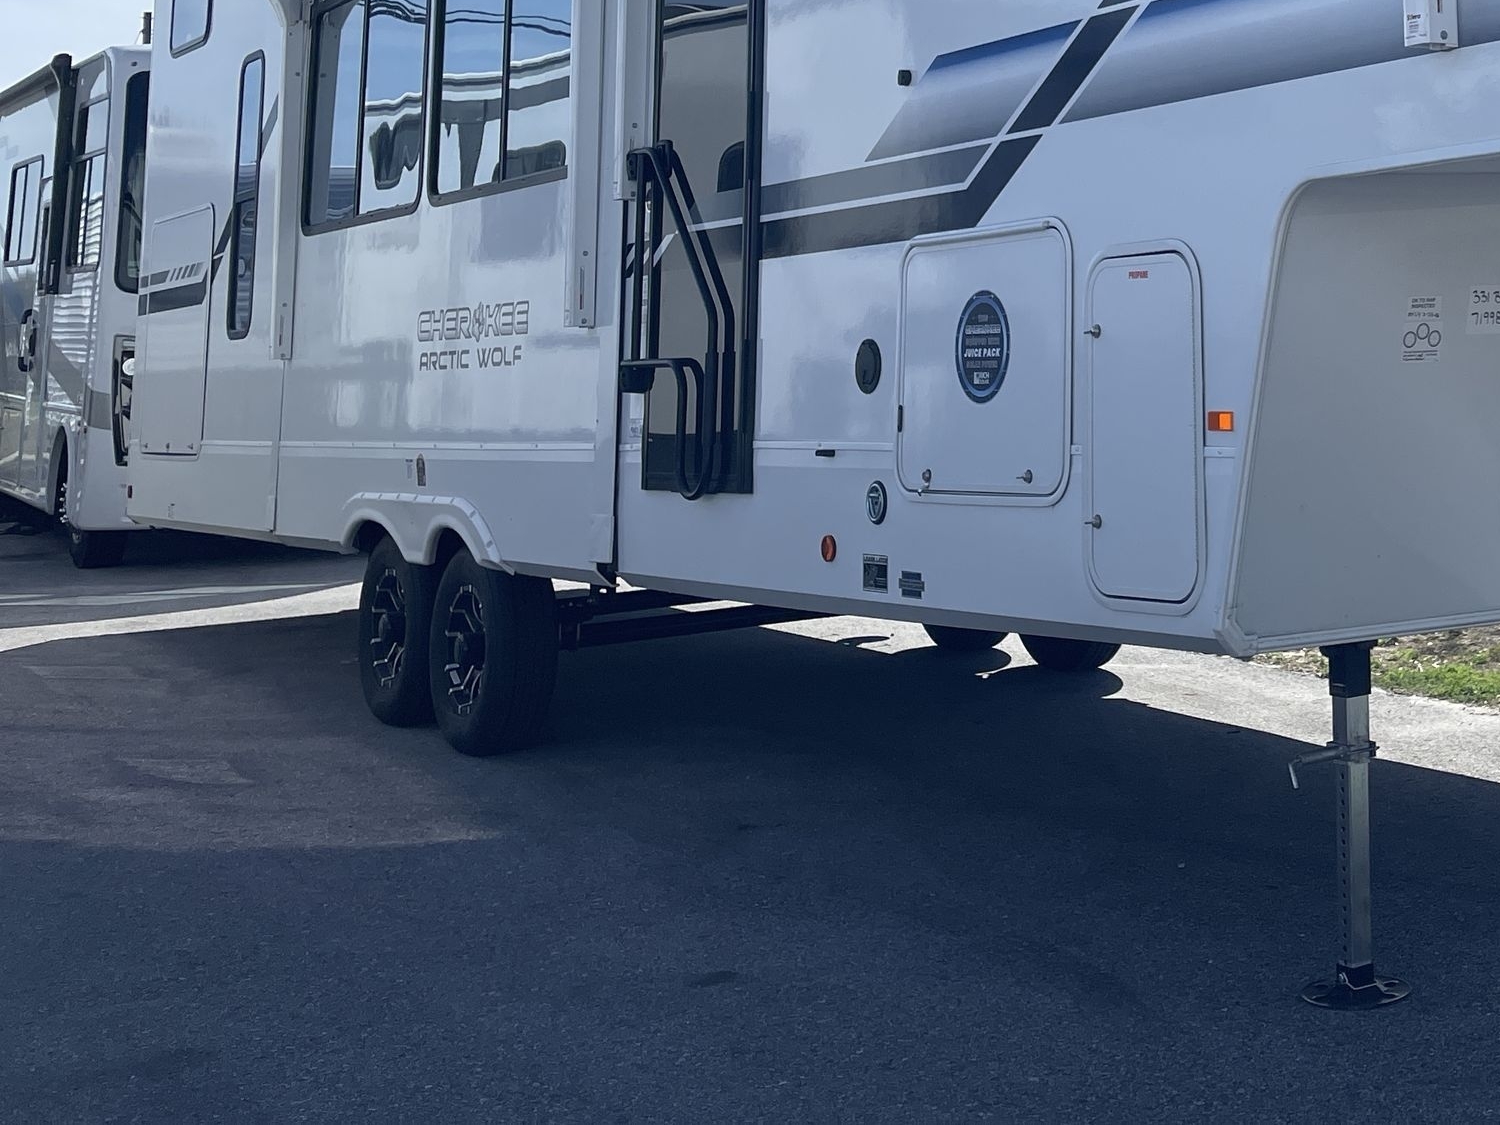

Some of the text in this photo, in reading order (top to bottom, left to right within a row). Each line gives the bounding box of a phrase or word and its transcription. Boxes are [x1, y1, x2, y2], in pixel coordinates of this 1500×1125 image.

[416, 300, 530, 343] CHEROKEE
[419, 345, 522, 372] ARCTIC WOLF
[964, 348, 1001, 358] JUICE PACK
